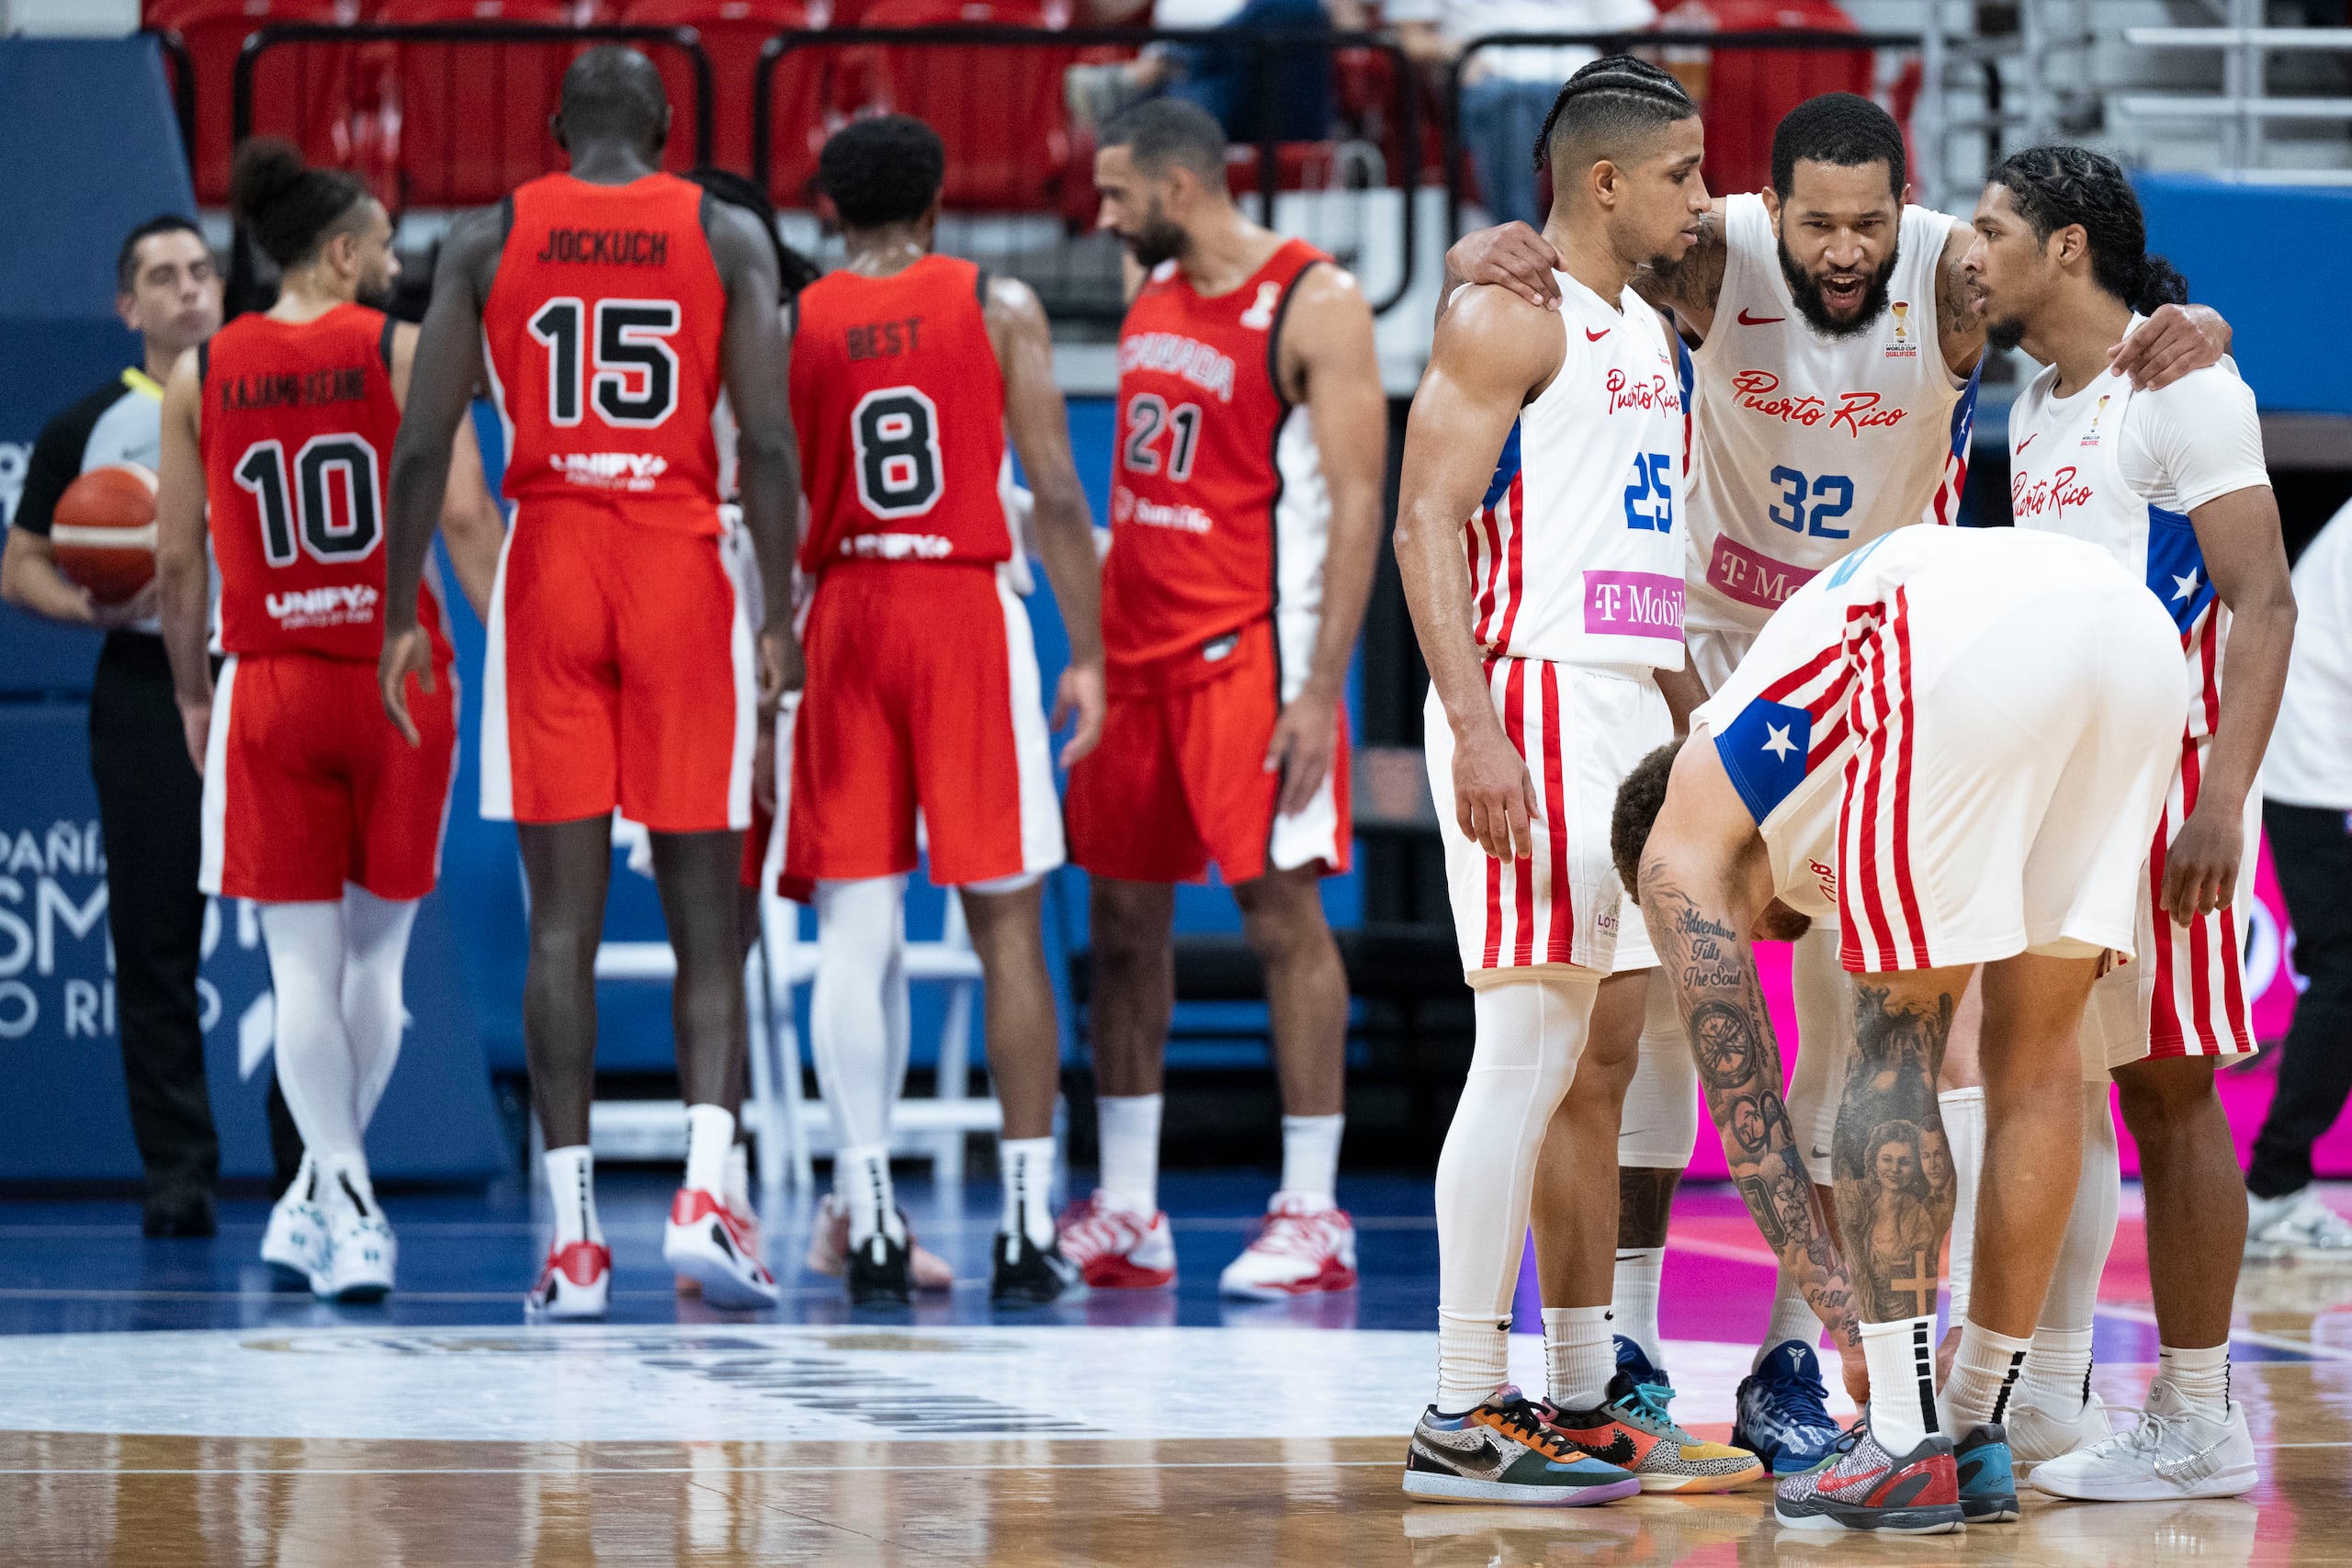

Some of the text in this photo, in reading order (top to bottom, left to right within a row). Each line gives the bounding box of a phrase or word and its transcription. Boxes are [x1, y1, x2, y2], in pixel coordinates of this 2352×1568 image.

[537, 228, 668, 265] JOCKUCH
[527, 297, 681, 429] 15
[847, 317, 922, 360] BEST
[1606, 368, 1679, 419] Puerto Rico
[1732, 370, 1908, 438] Puerto Rico
[851, 386, 944, 520] 8
[1124, 392, 1203, 483] 21
[233, 432, 383, 569] 10
[1624, 452, 1672, 534] 25
[1769, 465, 1854, 539] 32
[2013, 466, 2093, 523] Puerto Rico
[1677, 908, 1736, 942] Adventure
[1691, 938, 1721, 962] Fills
[1683, 965, 1741, 990] The Soul
[1810, 1289, 1842, 1308] 54:17
